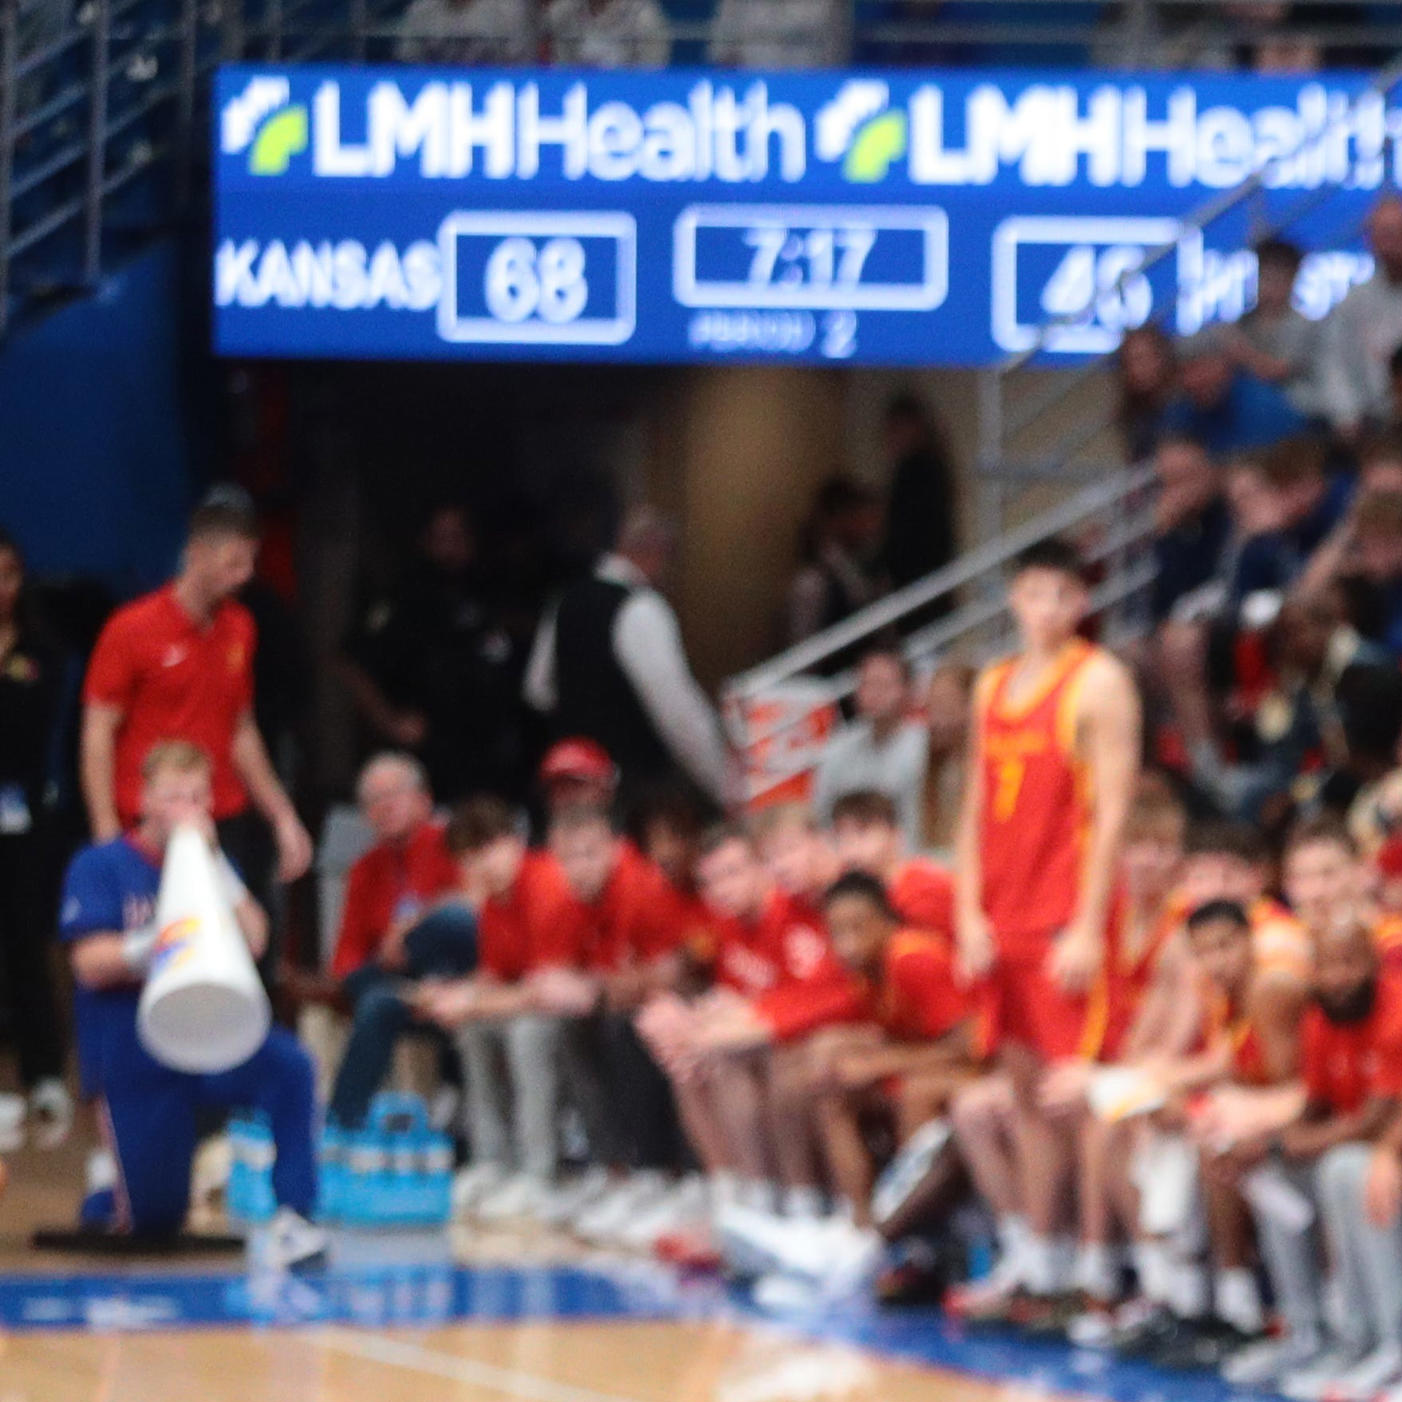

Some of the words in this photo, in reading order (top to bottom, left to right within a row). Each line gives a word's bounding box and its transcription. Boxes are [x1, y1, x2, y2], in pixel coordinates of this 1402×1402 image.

[215, 239, 443, 310] KANSAS
[485, 236, 588, 324] 68
[742, 221, 878, 291] 7:17
